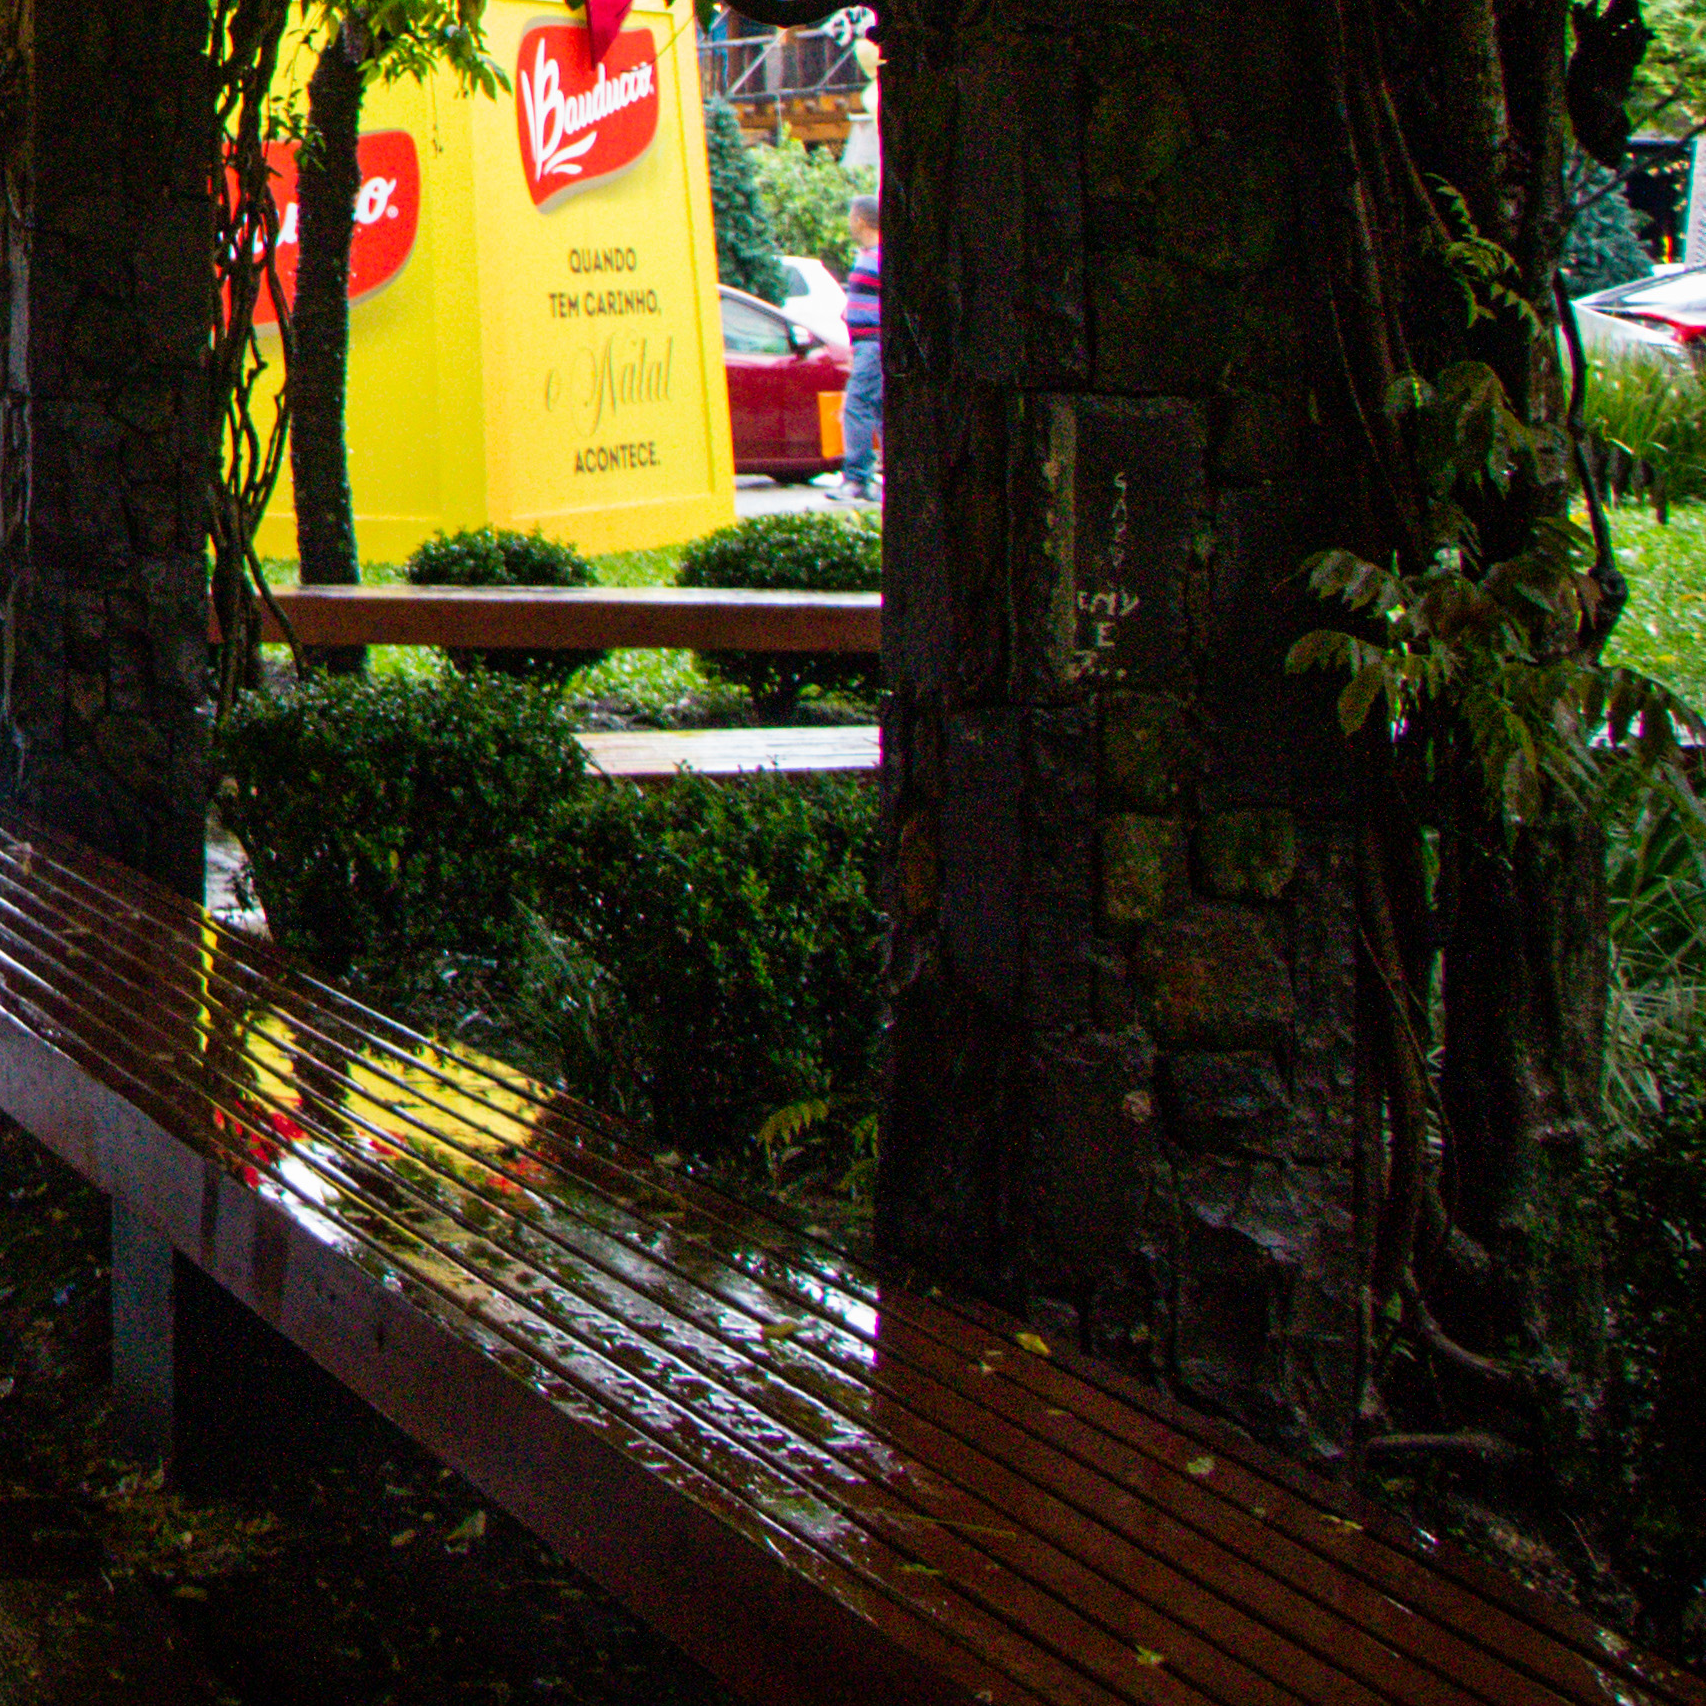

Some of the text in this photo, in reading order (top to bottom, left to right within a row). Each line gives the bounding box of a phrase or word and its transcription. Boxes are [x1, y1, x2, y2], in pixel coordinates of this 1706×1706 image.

[569, 247, 637, 274] QUANDO
[548, 288, 663, 318] TEM CARINHO,
[574, 441, 662, 475] ACONTECE.
